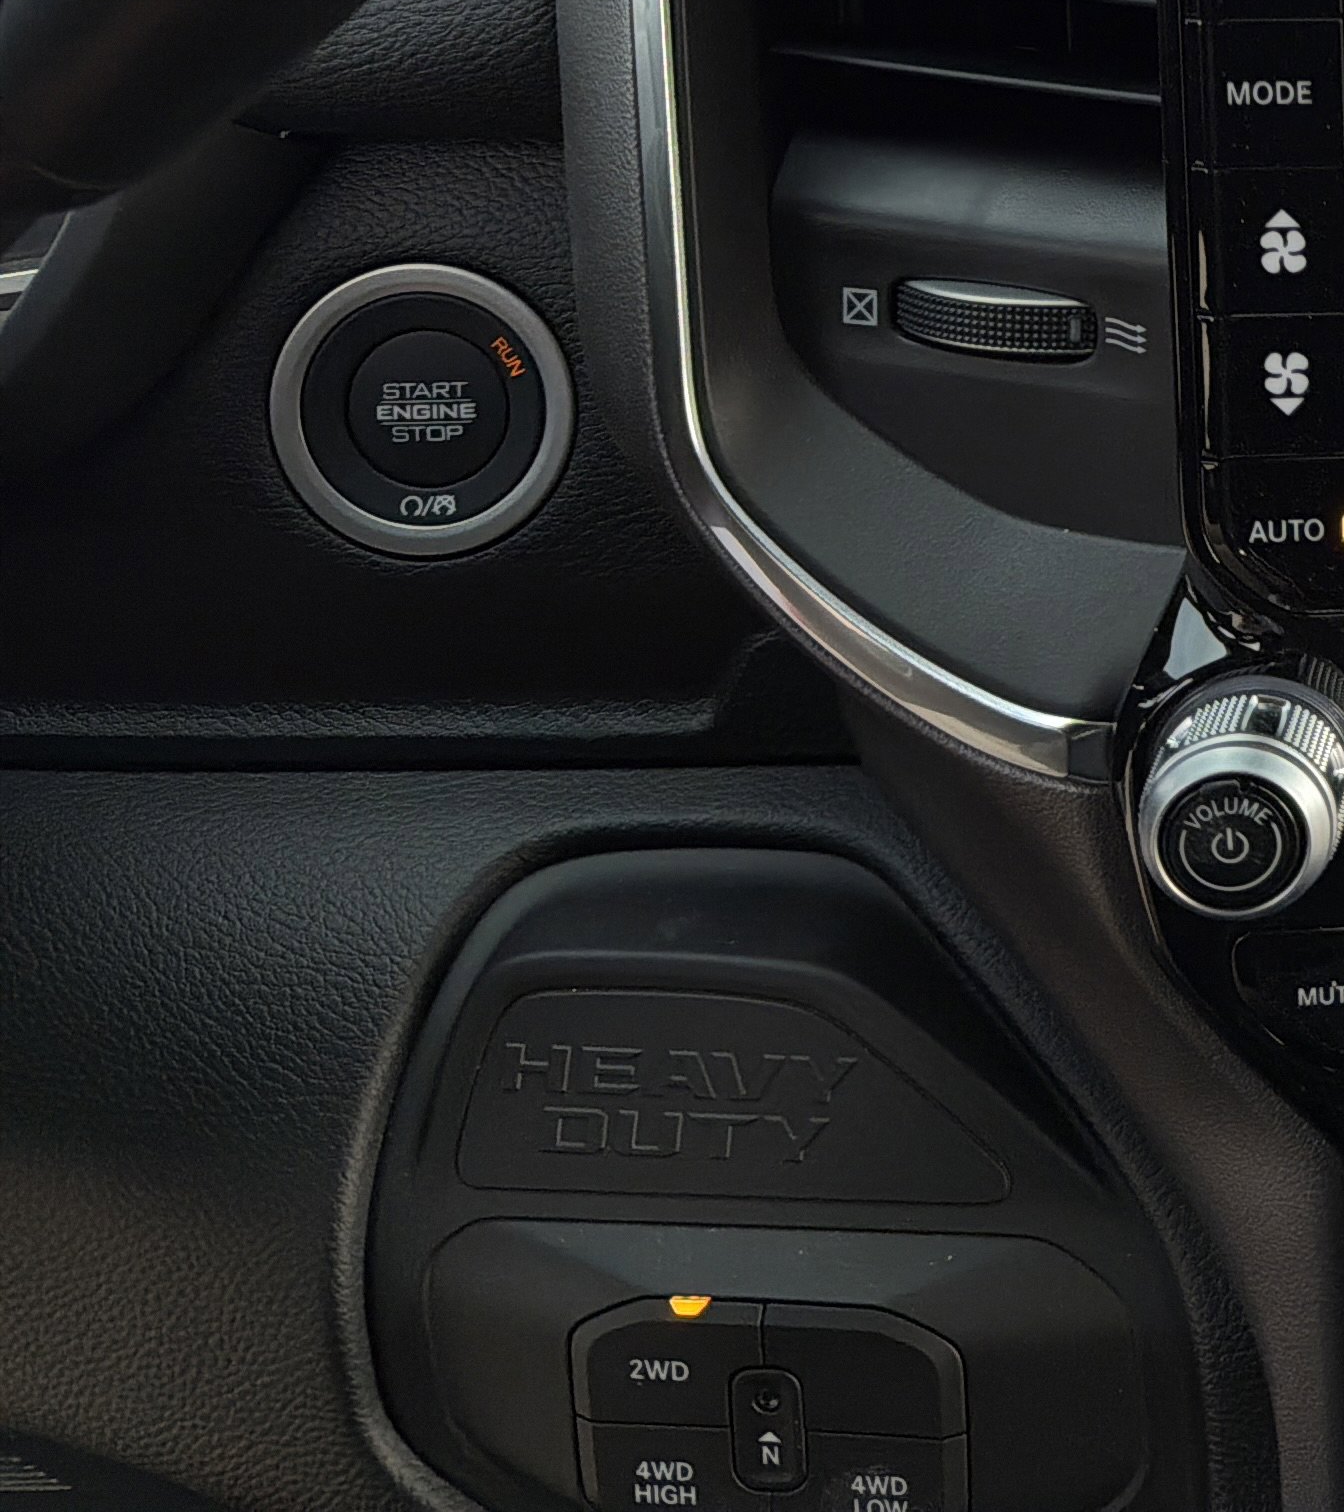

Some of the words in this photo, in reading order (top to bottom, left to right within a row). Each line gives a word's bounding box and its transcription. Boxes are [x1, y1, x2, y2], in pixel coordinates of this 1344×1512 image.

[1225, 79, 1315, 108] MODE
[490, 335, 528, 378] RUN
[382, 381, 469, 400] START
[376, 403, 478, 421] ENGINE
[390, 425, 464, 444] STOP
[1248, 518, 1325, 544] AUTO
[1183, 796, 1274, 831] VOLUME
[502, 1041, 859, 1102] HEAVY
[538, 1105, 832, 1164] DUTY
[629, 1358, 690, 1382] 2WD
[761, 1445, 780, 1465] N
[635, 1460, 694, 1482] 4WD
[634, 1483, 697, 1506] HIGH
[850, 1475, 908, 1496] 4WD
[850, 1497, 912, 1512] LOW
